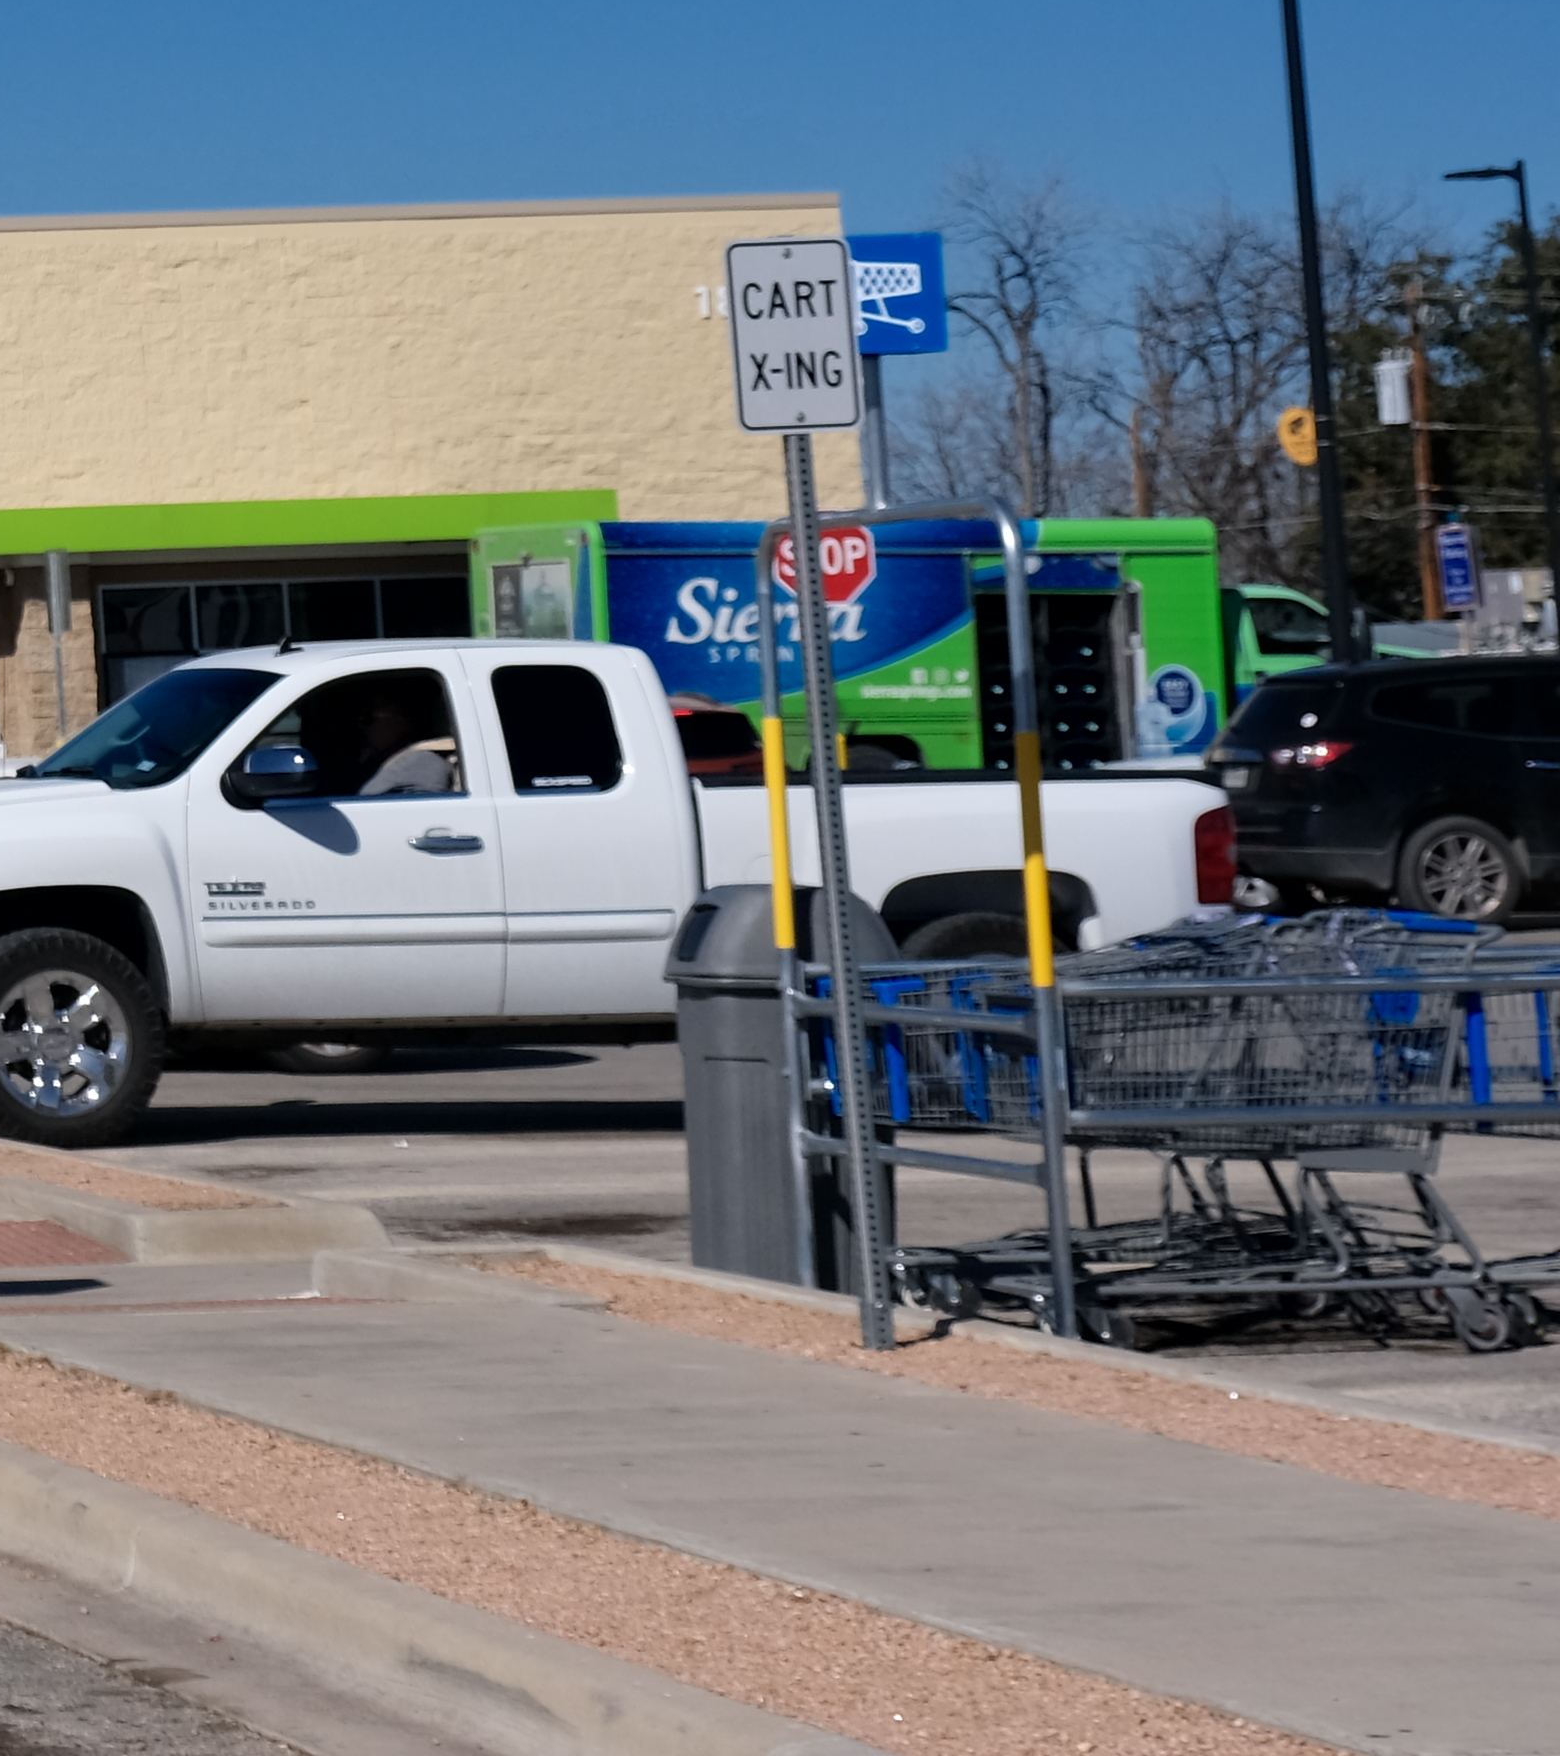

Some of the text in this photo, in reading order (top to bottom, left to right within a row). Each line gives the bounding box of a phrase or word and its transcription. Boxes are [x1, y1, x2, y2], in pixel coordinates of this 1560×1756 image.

[742, 279, 838, 320] CART
[750, 350, 843, 392] X-ING
[778, 536, 867, 576] SOP
[207, 900, 317, 911] SILVERADO
